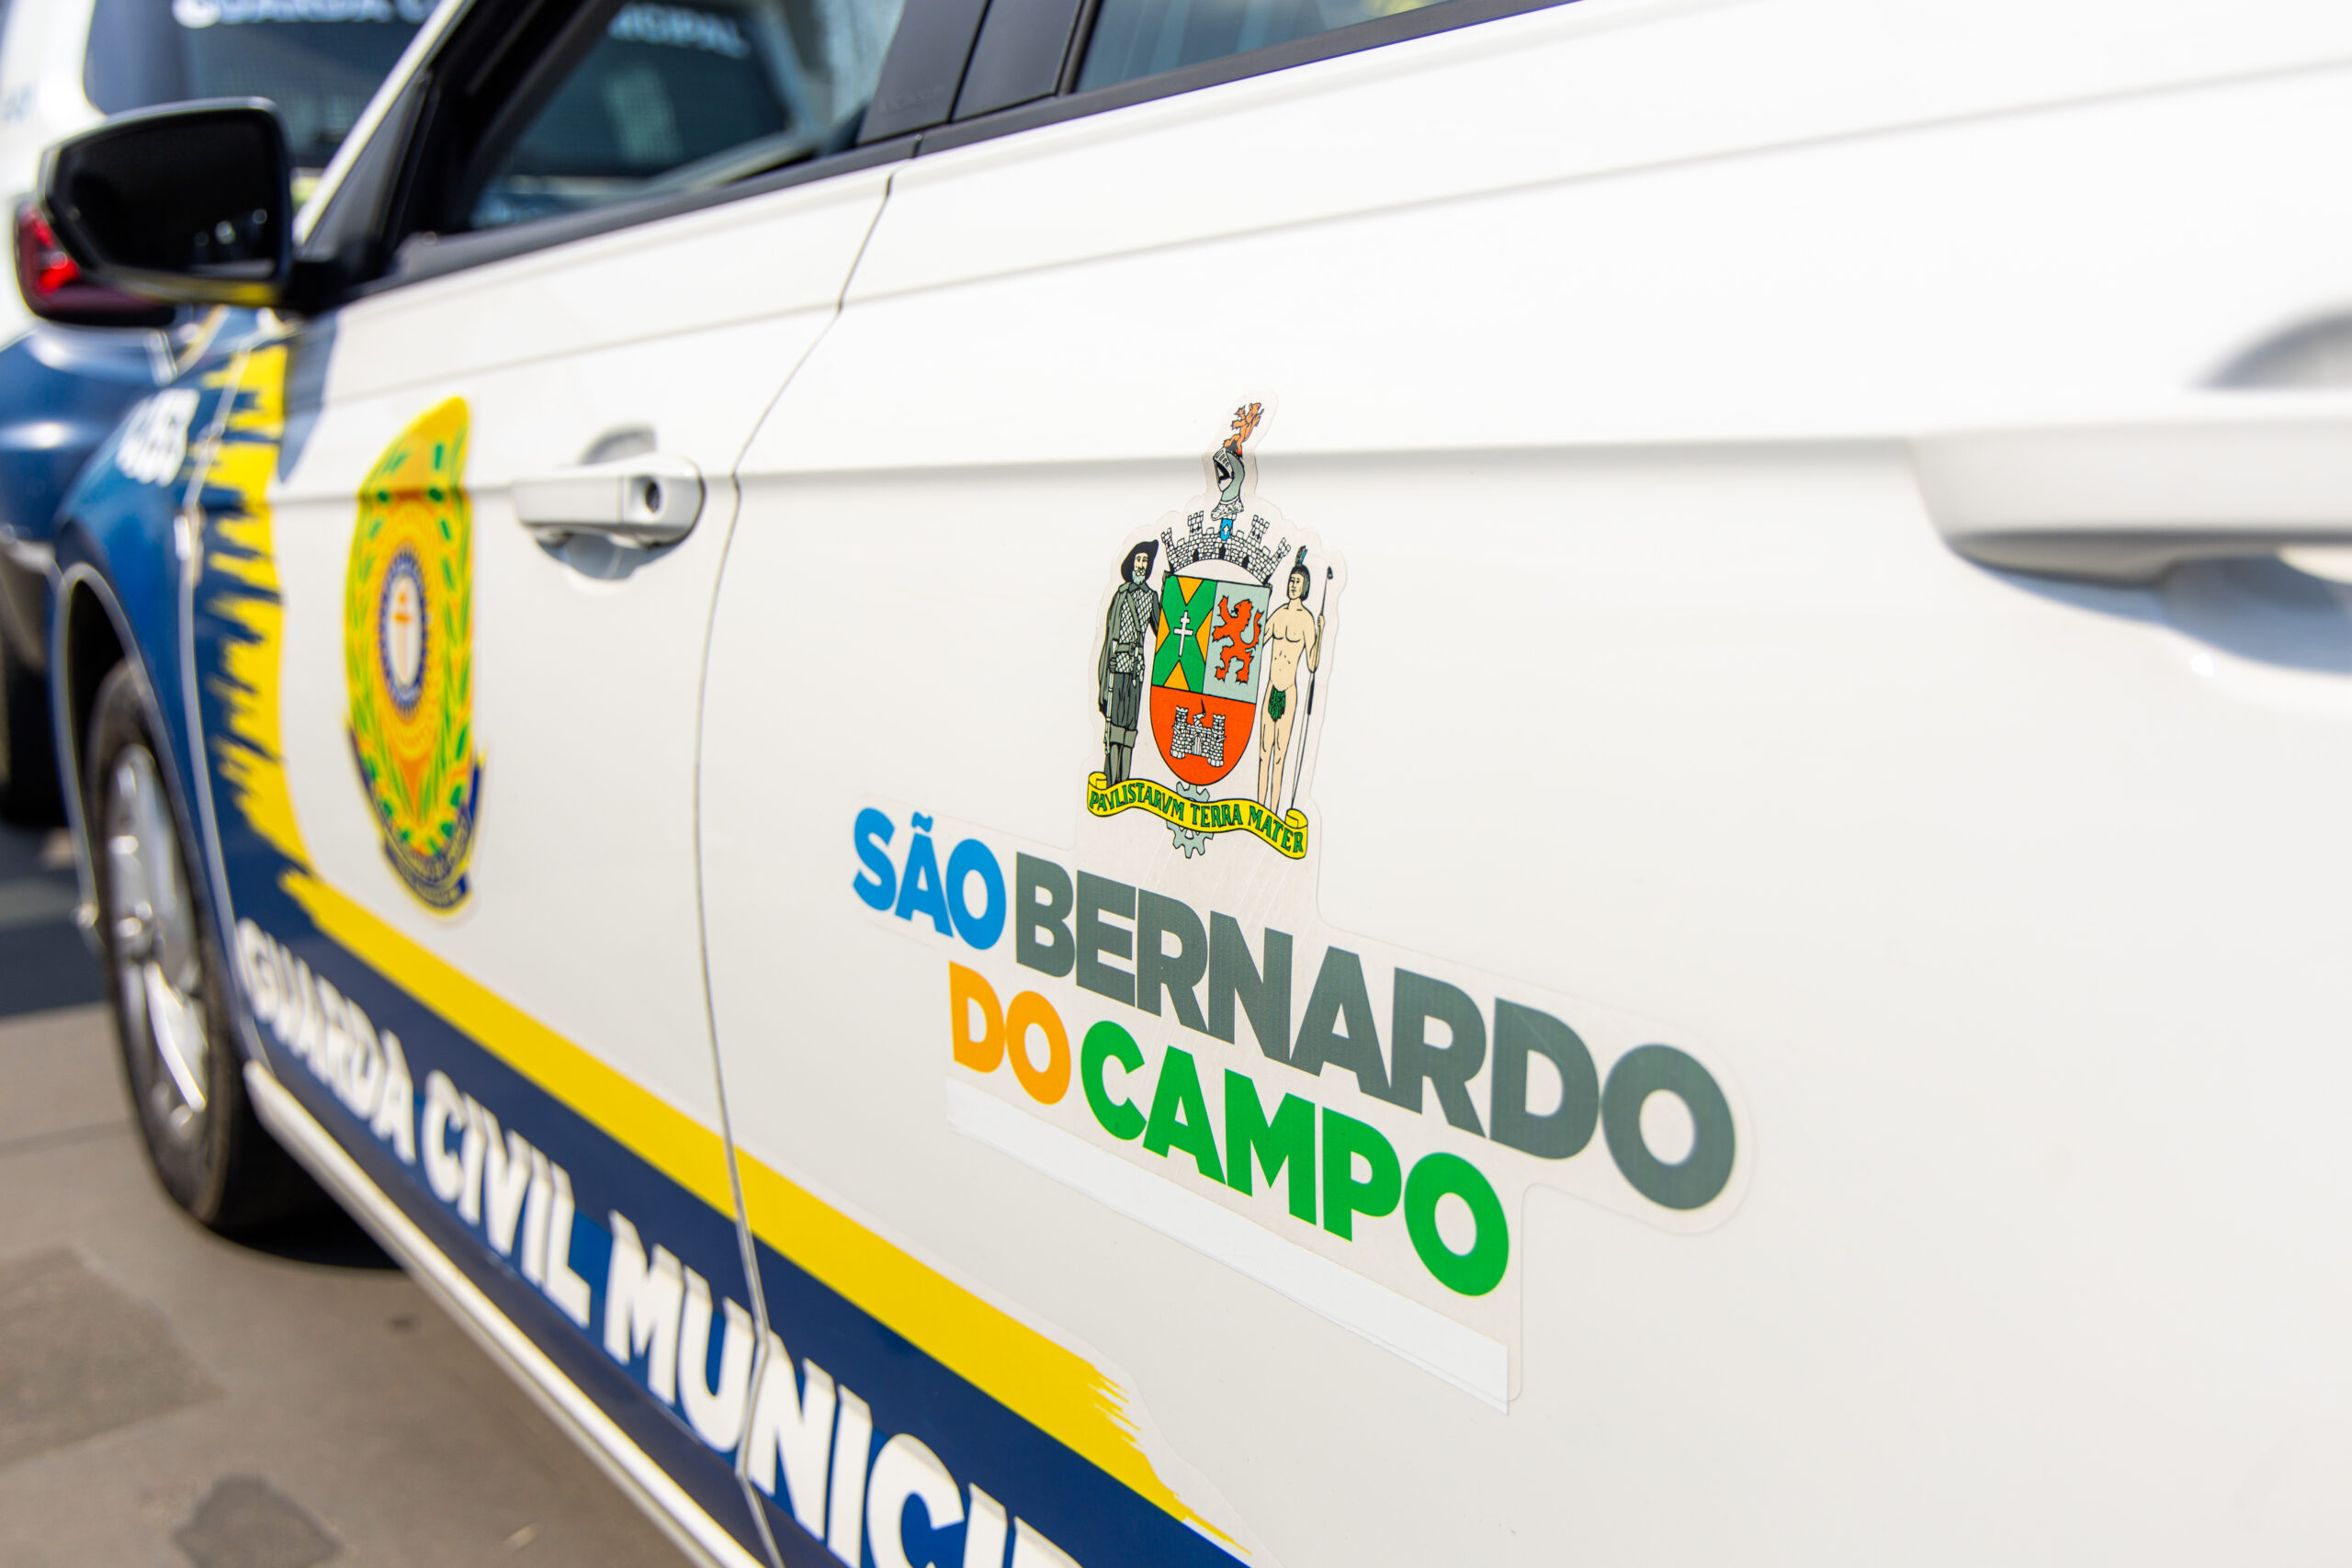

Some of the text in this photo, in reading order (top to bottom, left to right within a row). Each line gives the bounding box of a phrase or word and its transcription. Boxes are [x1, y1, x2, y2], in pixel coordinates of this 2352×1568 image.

[1090, 783, 1304, 853] PAVLISTARVM TERRA MATER
[853, 807, 1736, 1211] SÃO BERNARDO
[948, 961, 1510, 1296] DO CAMPO
[237, 917, 1084, 1568] GUARDA CIVIL MUNIC
